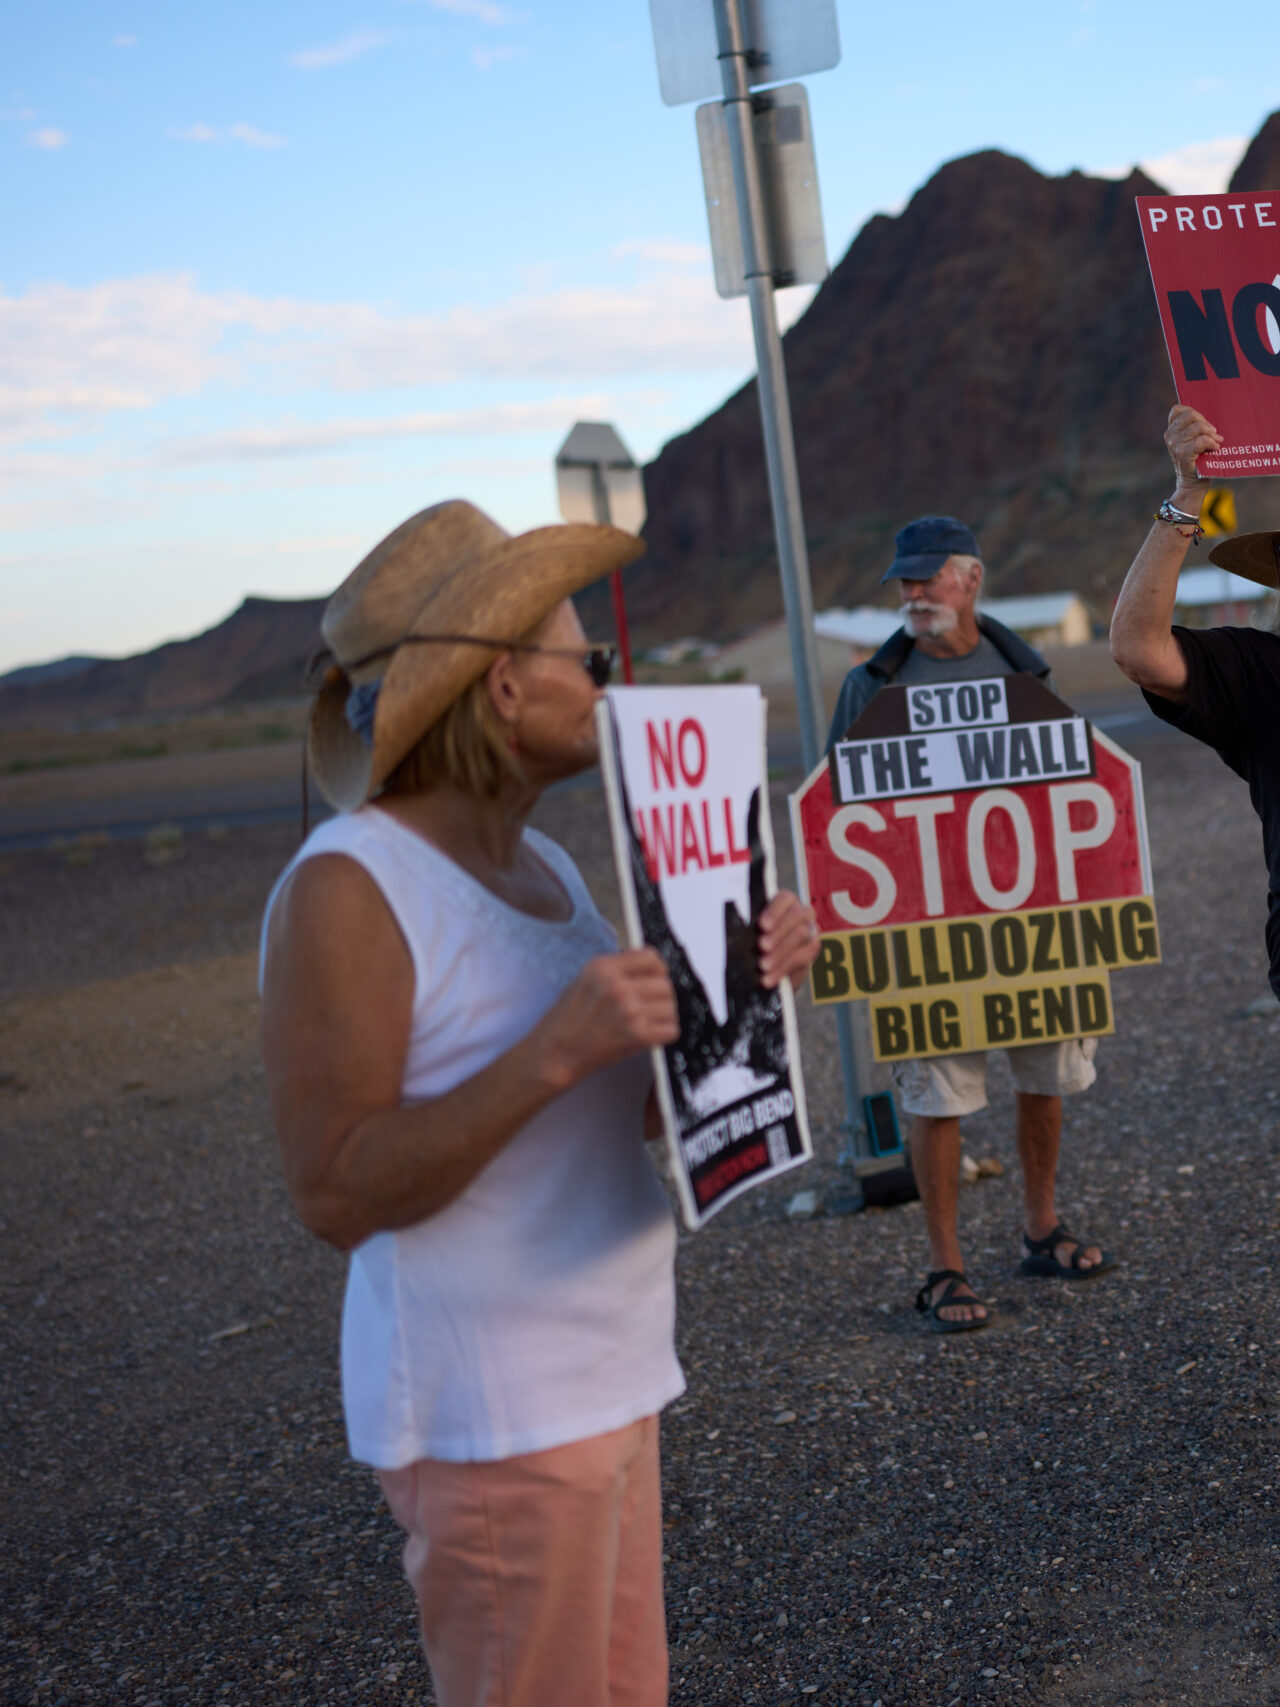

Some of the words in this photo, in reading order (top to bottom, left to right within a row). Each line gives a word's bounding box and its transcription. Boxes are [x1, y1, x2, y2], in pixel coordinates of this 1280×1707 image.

[910, 684, 1003, 727] STOP
[646, 717, 708, 792] NO
[840, 737, 932, 796] THE
[957, 722, 1086, 784] WALL
[637, 797, 752, 883] WALL
[827, 782, 1117, 926] STOP
[812, 901, 1159, 999] BULLDOZING
[875, 998, 962, 1057] BIG
[983, 982, 1109, 1043] BEND
[752, 1089, 795, 1130] BEND
